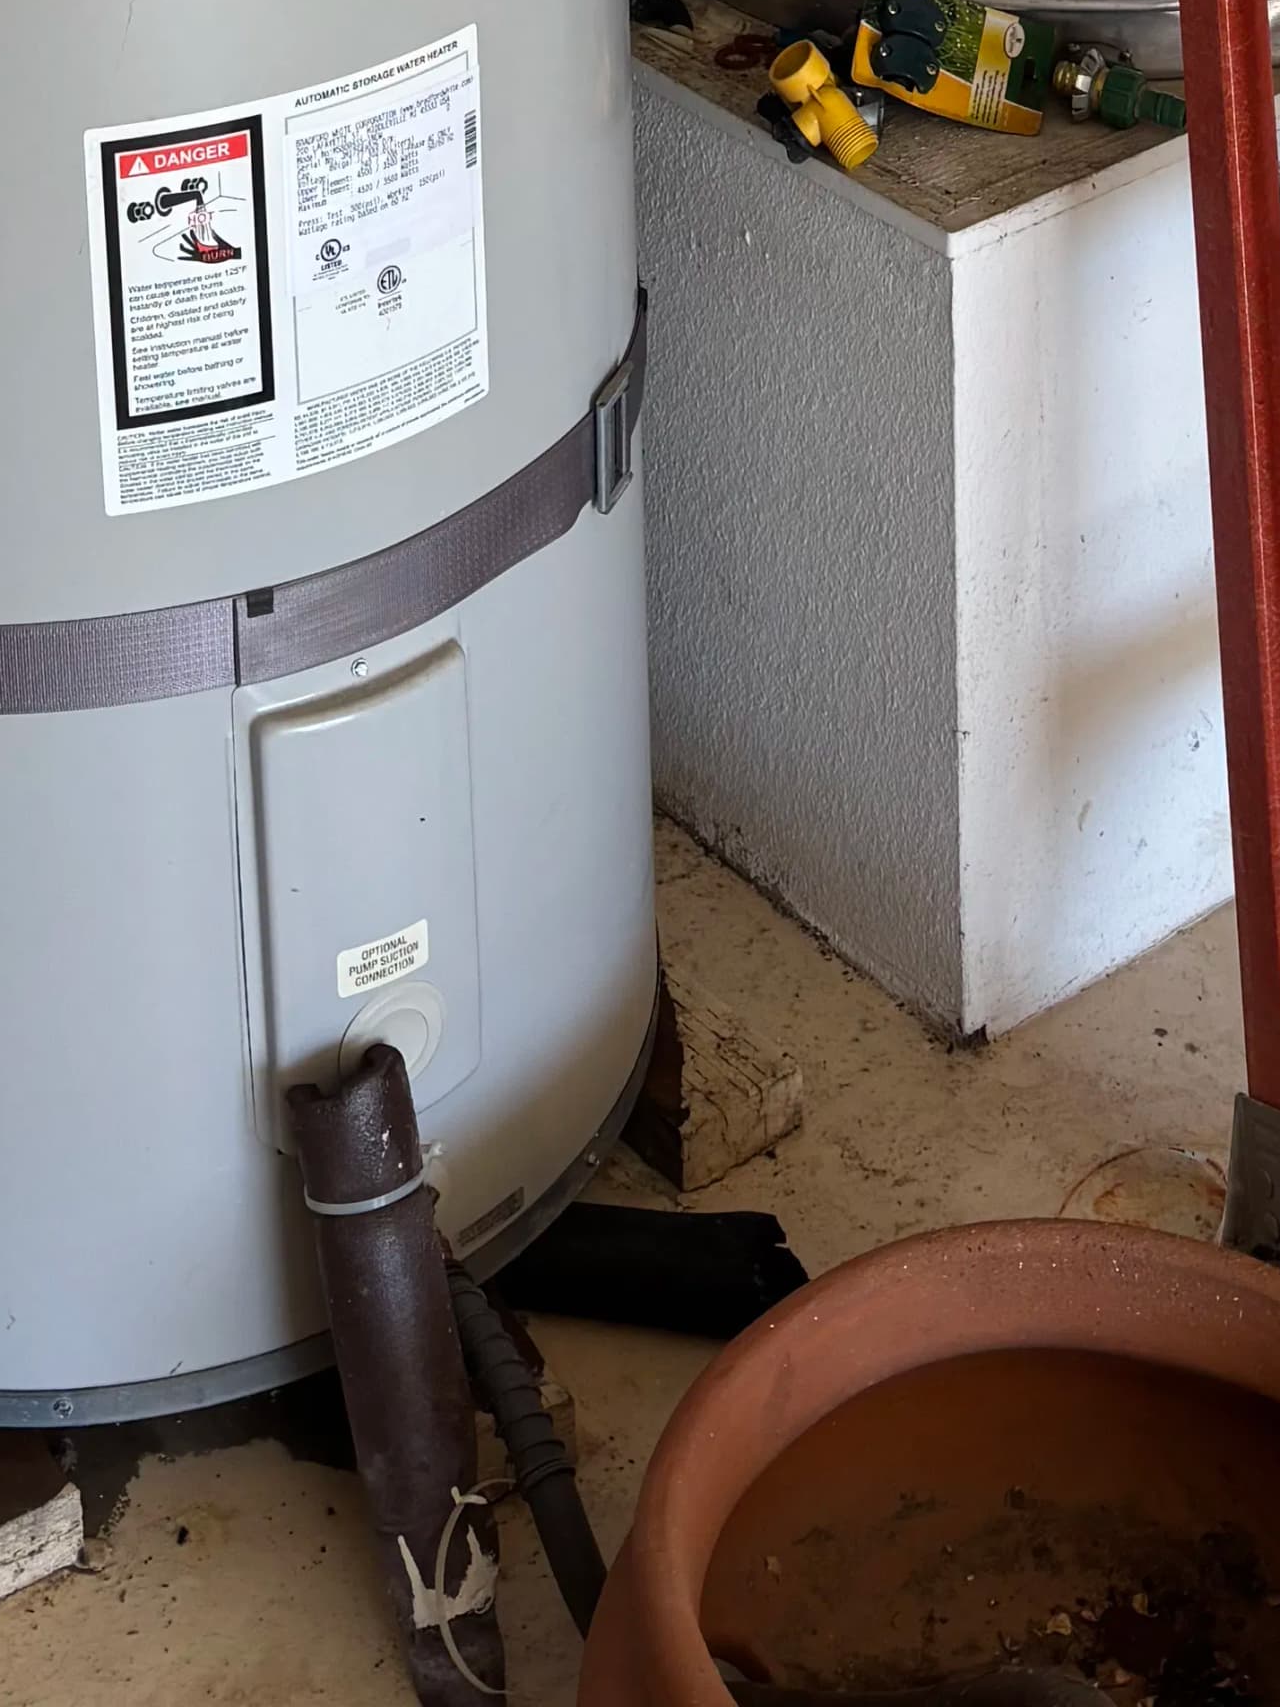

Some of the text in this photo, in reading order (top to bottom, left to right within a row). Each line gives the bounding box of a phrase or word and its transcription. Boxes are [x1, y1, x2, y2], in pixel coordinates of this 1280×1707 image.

[295, 40, 458, 108] AUTOMATIC STORAGE WATER HEATER
[154, 142, 230, 169] DANGER
[187, 212, 214, 225] HOT
[202, 249, 234, 261] BURN
[128, 284, 152, 293] Water
[129, 294, 144, 303] can
[175, 293, 197, 304] death
[204, 303, 218, 312] and
[156, 317, 185, 330] highest
[187, 316, 201, 324] risk
[203, 313, 211, 321] of
[213, 309, 234, 319] being
[161, 344, 209, 359] temperature
[205, 359, 233, 371] bathing
[361, 936, 407, 960] OPTIONAL
[349, 940, 419, 976] PUMP SUCTION
[355, 955, 415, 987] CONNECTION
